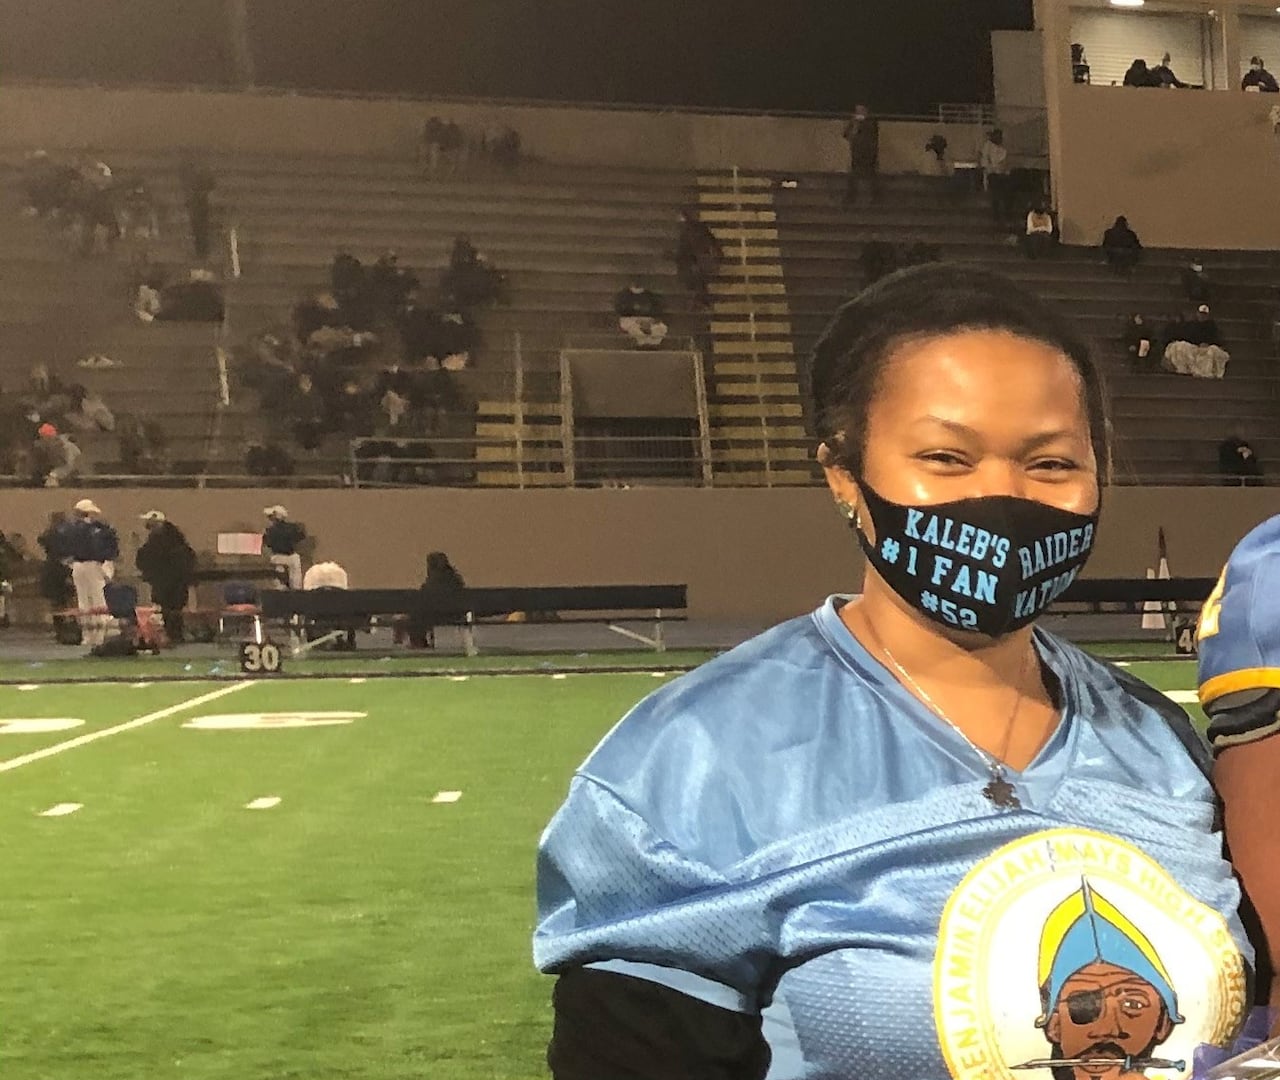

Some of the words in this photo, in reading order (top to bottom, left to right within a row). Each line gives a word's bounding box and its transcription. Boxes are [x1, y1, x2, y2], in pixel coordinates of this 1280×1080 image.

[904, 507, 1011, 569] KALEB'S
[931, 554, 999, 605] FAN
[920, 590, 980, 631] #52
[244, 643, 279, 671] 30
[959, 846, 1047, 924] ELIJAH
[1051, 838, 1132, 876] MAYS
[1138, 868, 1207, 927] HIGH
